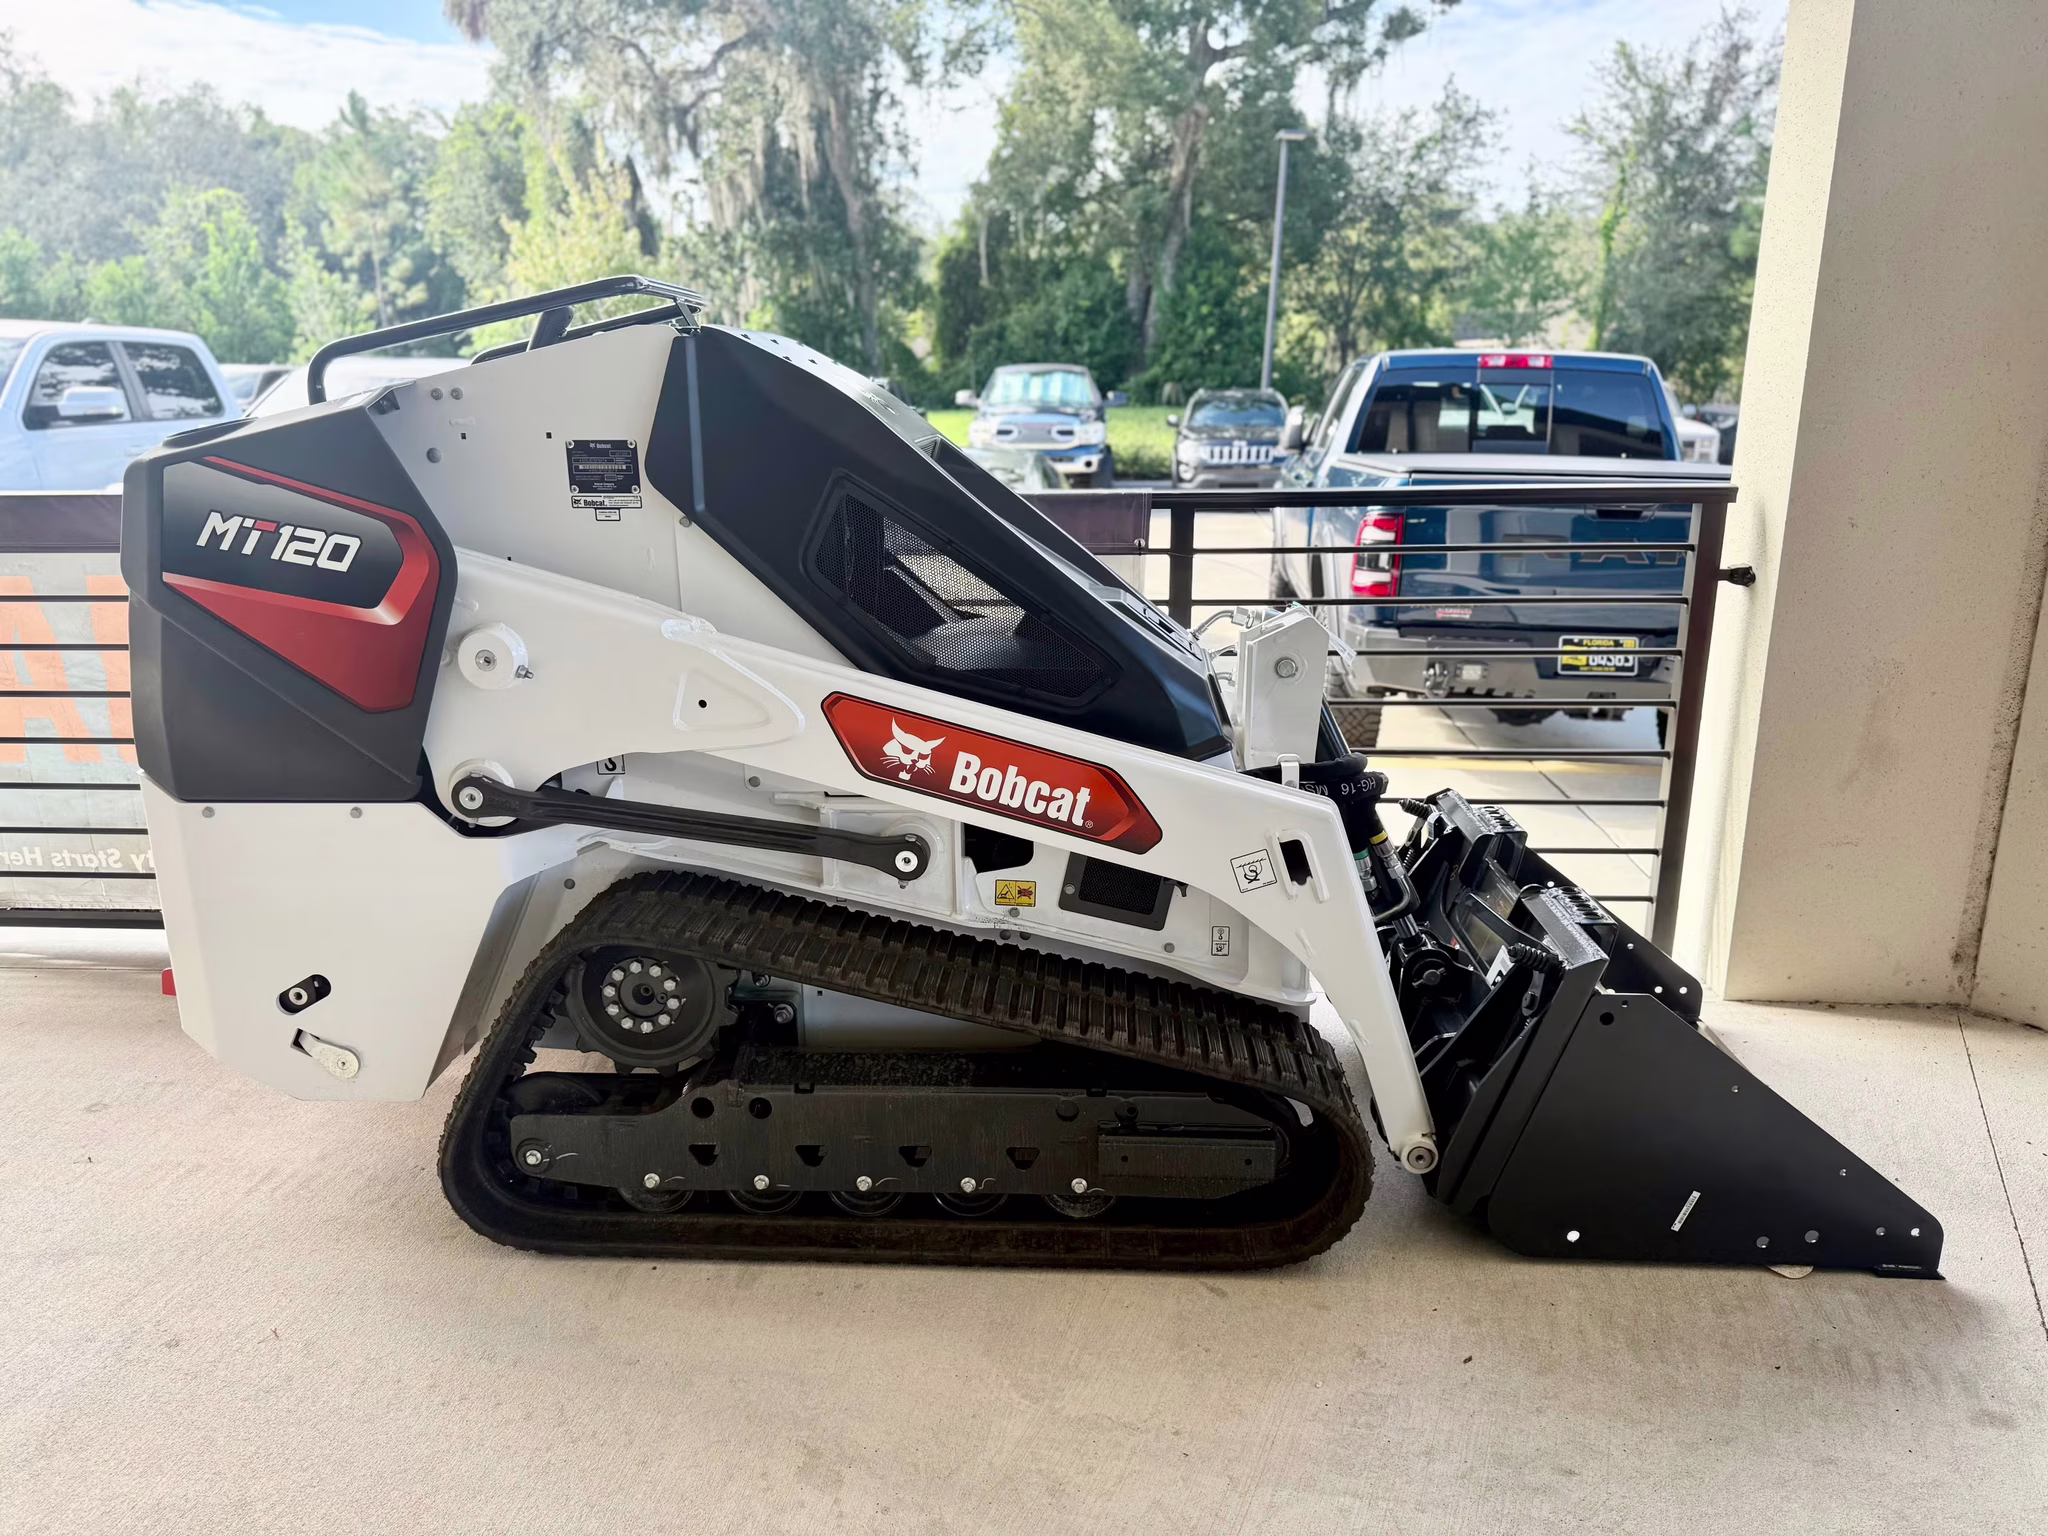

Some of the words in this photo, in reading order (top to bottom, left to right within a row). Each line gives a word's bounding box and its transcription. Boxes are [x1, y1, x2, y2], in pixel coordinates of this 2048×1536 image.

[196, 511, 362, 572] MT120
[1583, 639, 1615, 647] FLORIDA
[949, 751, 1091, 826] Bobcat
[1341, 776, 1376, 795] HG-16
